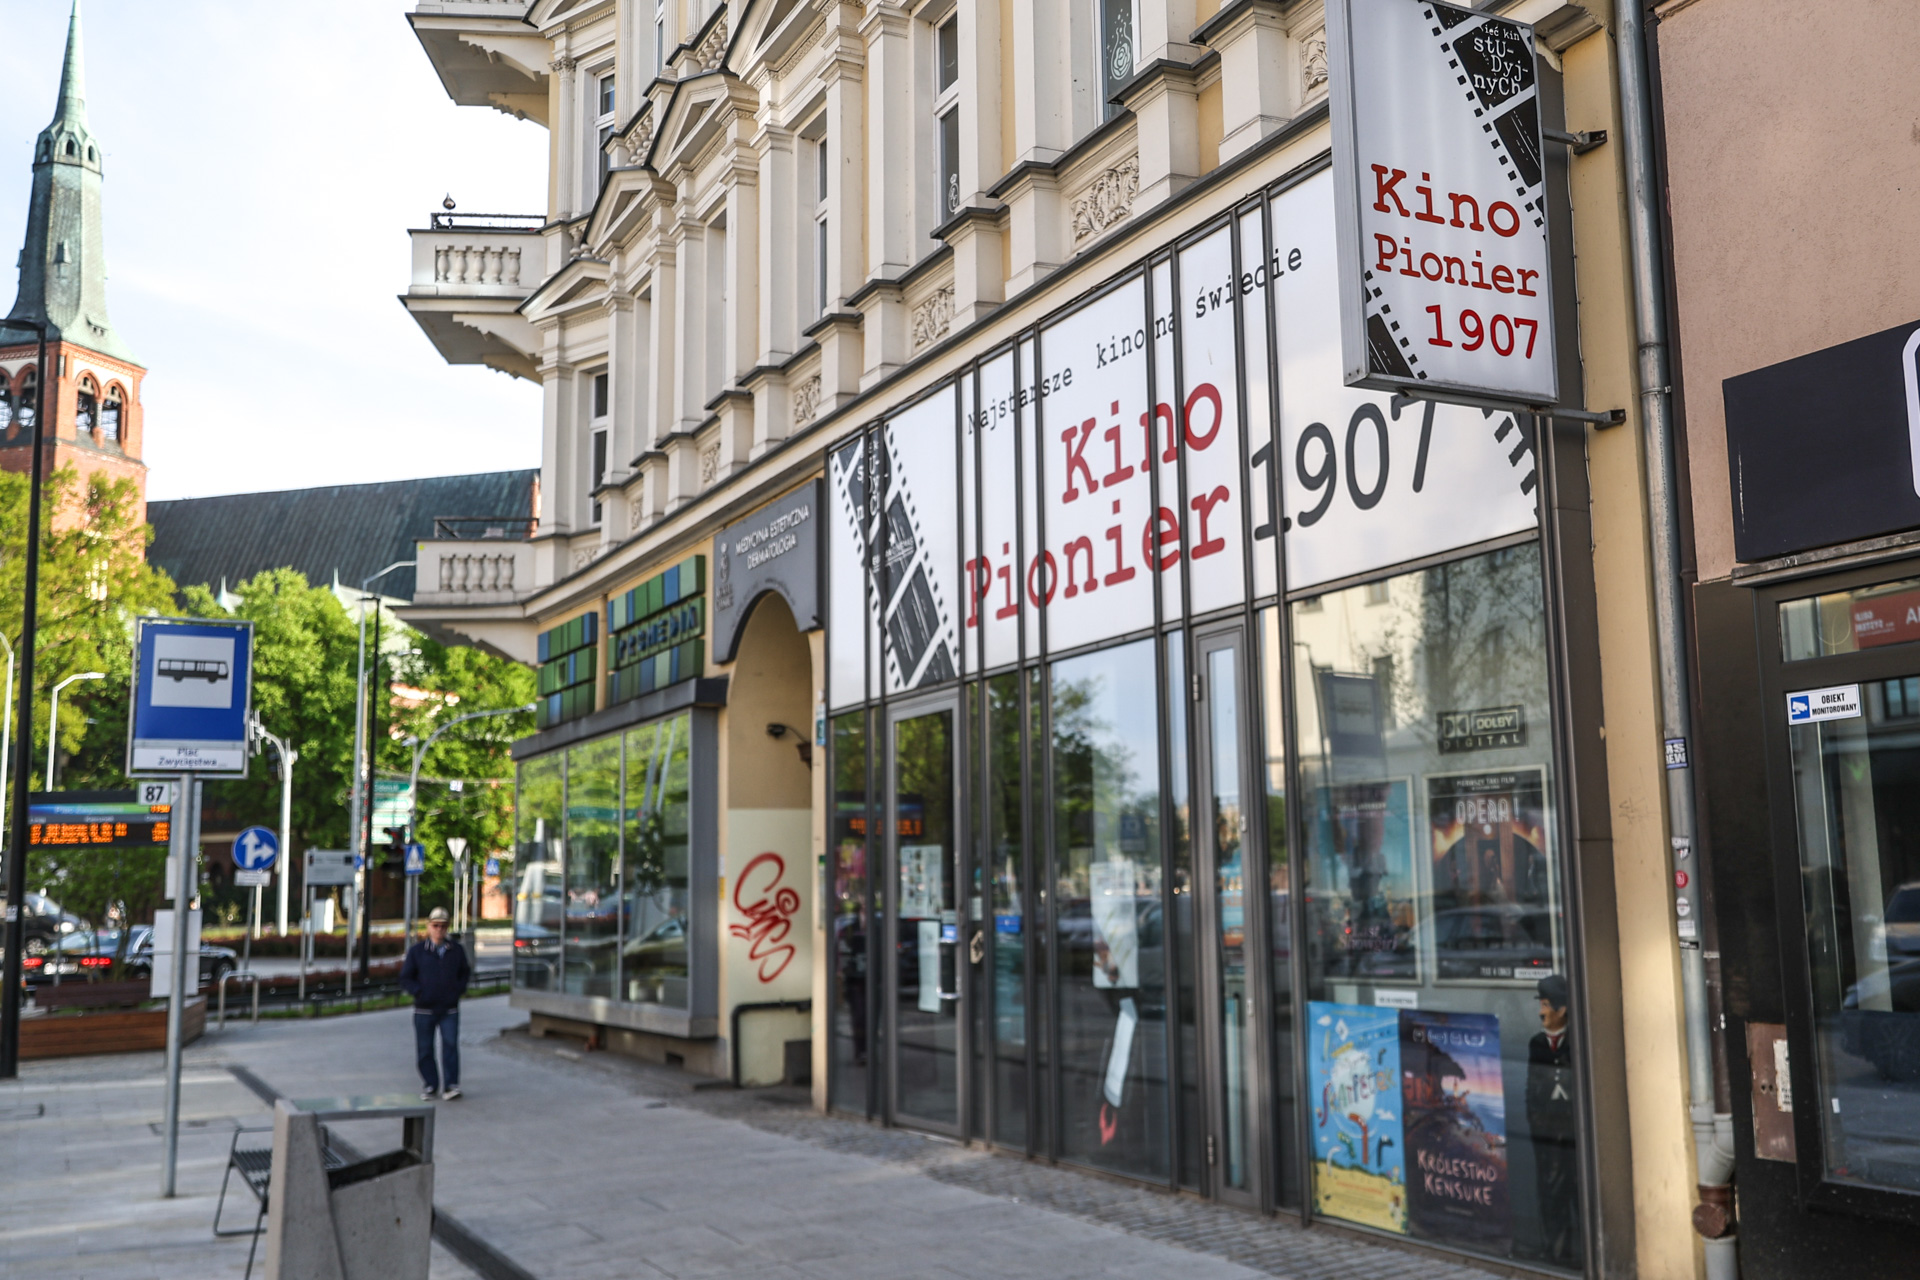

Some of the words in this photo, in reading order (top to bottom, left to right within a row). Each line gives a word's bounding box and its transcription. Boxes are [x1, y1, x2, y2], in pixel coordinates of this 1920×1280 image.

[1503, 29, 1520, 40] kin
[1371, 164, 1520, 238] Kino
[1374, 233, 1539, 297] Pionier
[1096, 329, 1145, 369] kino
[1196, 248, 1302, 319] świecie
[1426, 305, 1538, 359] 1907
[1061, 382, 1222, 504] Kino
[1251, 393, 1436, 541] 1907
[965, 485, 1230, 628] Pionier
[1812, 703, 1857, 716] MONITOROWANY
[1821, 693, 1845, 705] OBIEKT
[1476, 716, 1513, 729] DOLBY
[1444, 734, 1519, 750] DIGITAL
[145, 785, 165, 803] 87
[1417, 1150, 1497, 1182] KRÓLESTWO
[1424, 1172, 1492, 1206] KENSUKE
